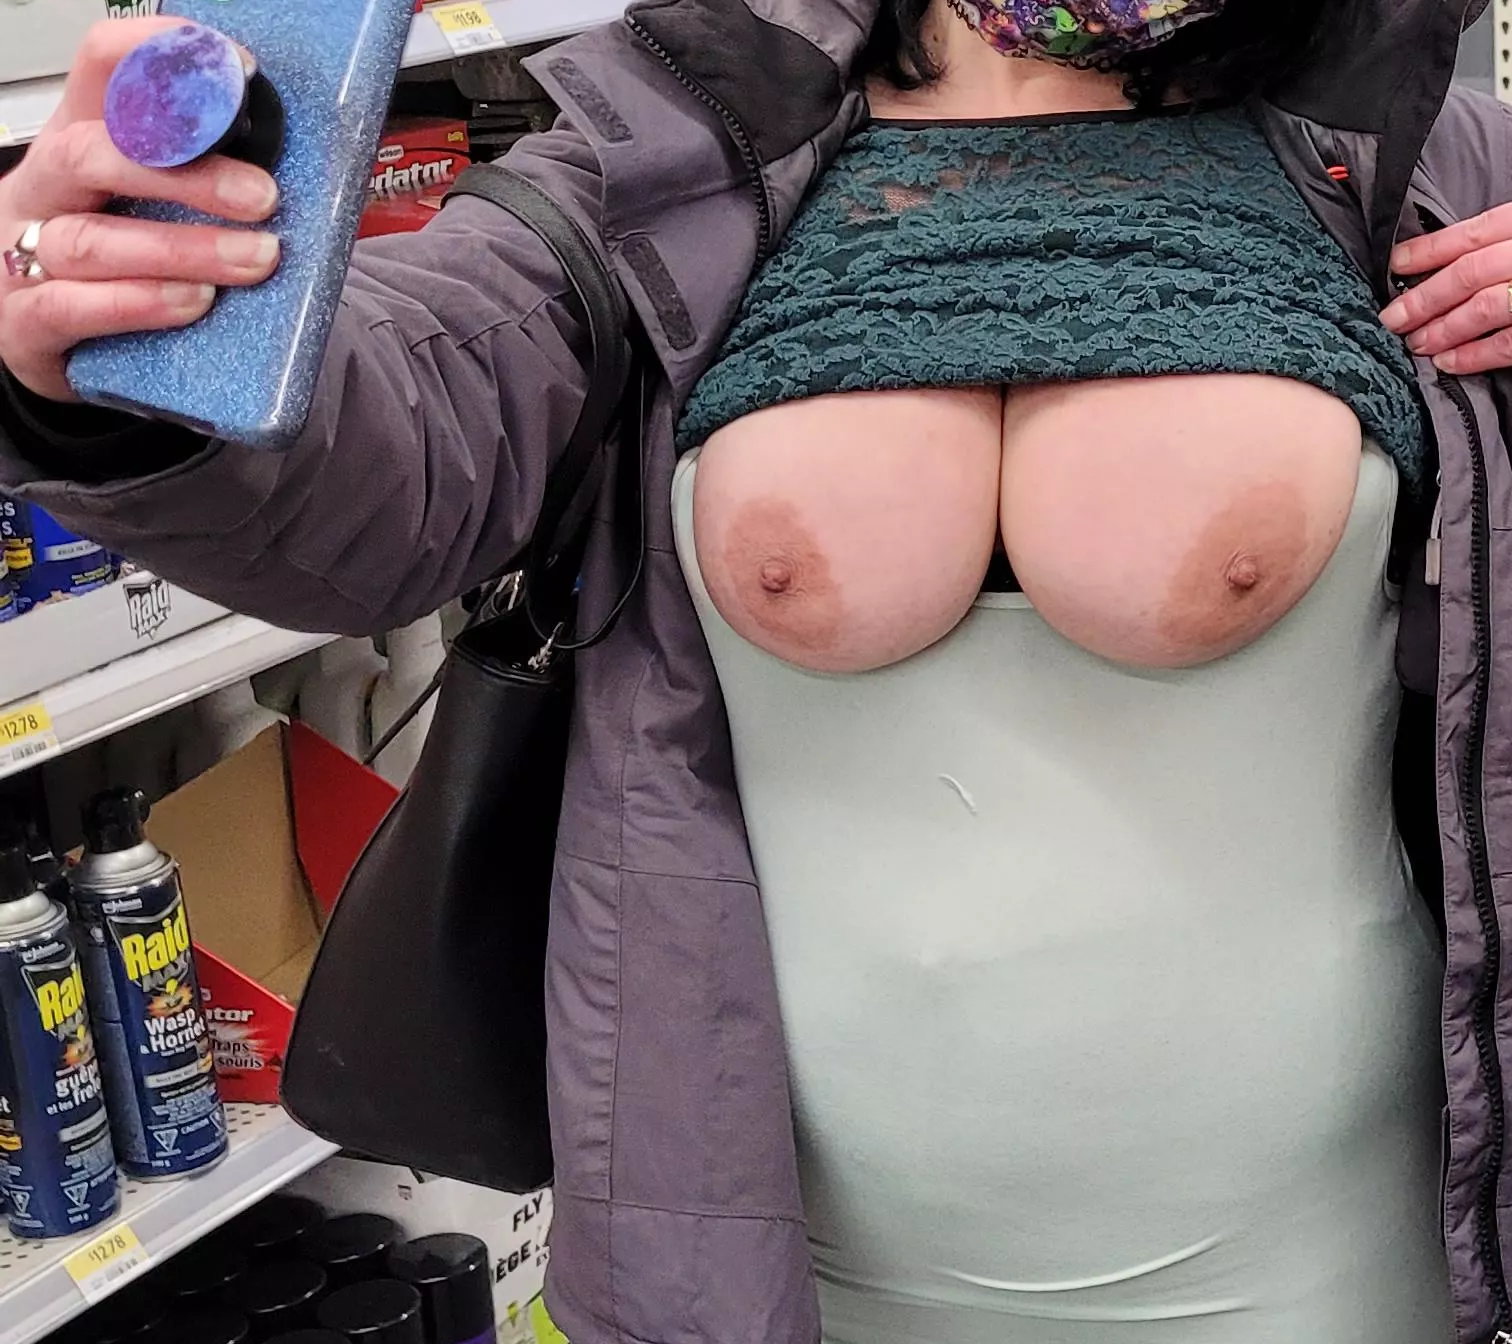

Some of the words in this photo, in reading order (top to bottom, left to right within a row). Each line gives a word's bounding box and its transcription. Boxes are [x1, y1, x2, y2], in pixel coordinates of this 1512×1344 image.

[367, 159, 453, 199] dator
[131, 579, 170, 629] Raid
[122, 906, 190, 981] Raid
[142, 950, 191, 993] MAX
[38, 963, 86, 1032] Rai
[144, 1008, 196, 1036] Wasp
[150, 1016, 207, 1054] Hornet
[55, 1057, 99, 1099] guêp
[218, 1056, 263, 1070] souris
[513, 1192, 543, 1233] FLY
[494, 1239, 532, 1284] ÈGE
